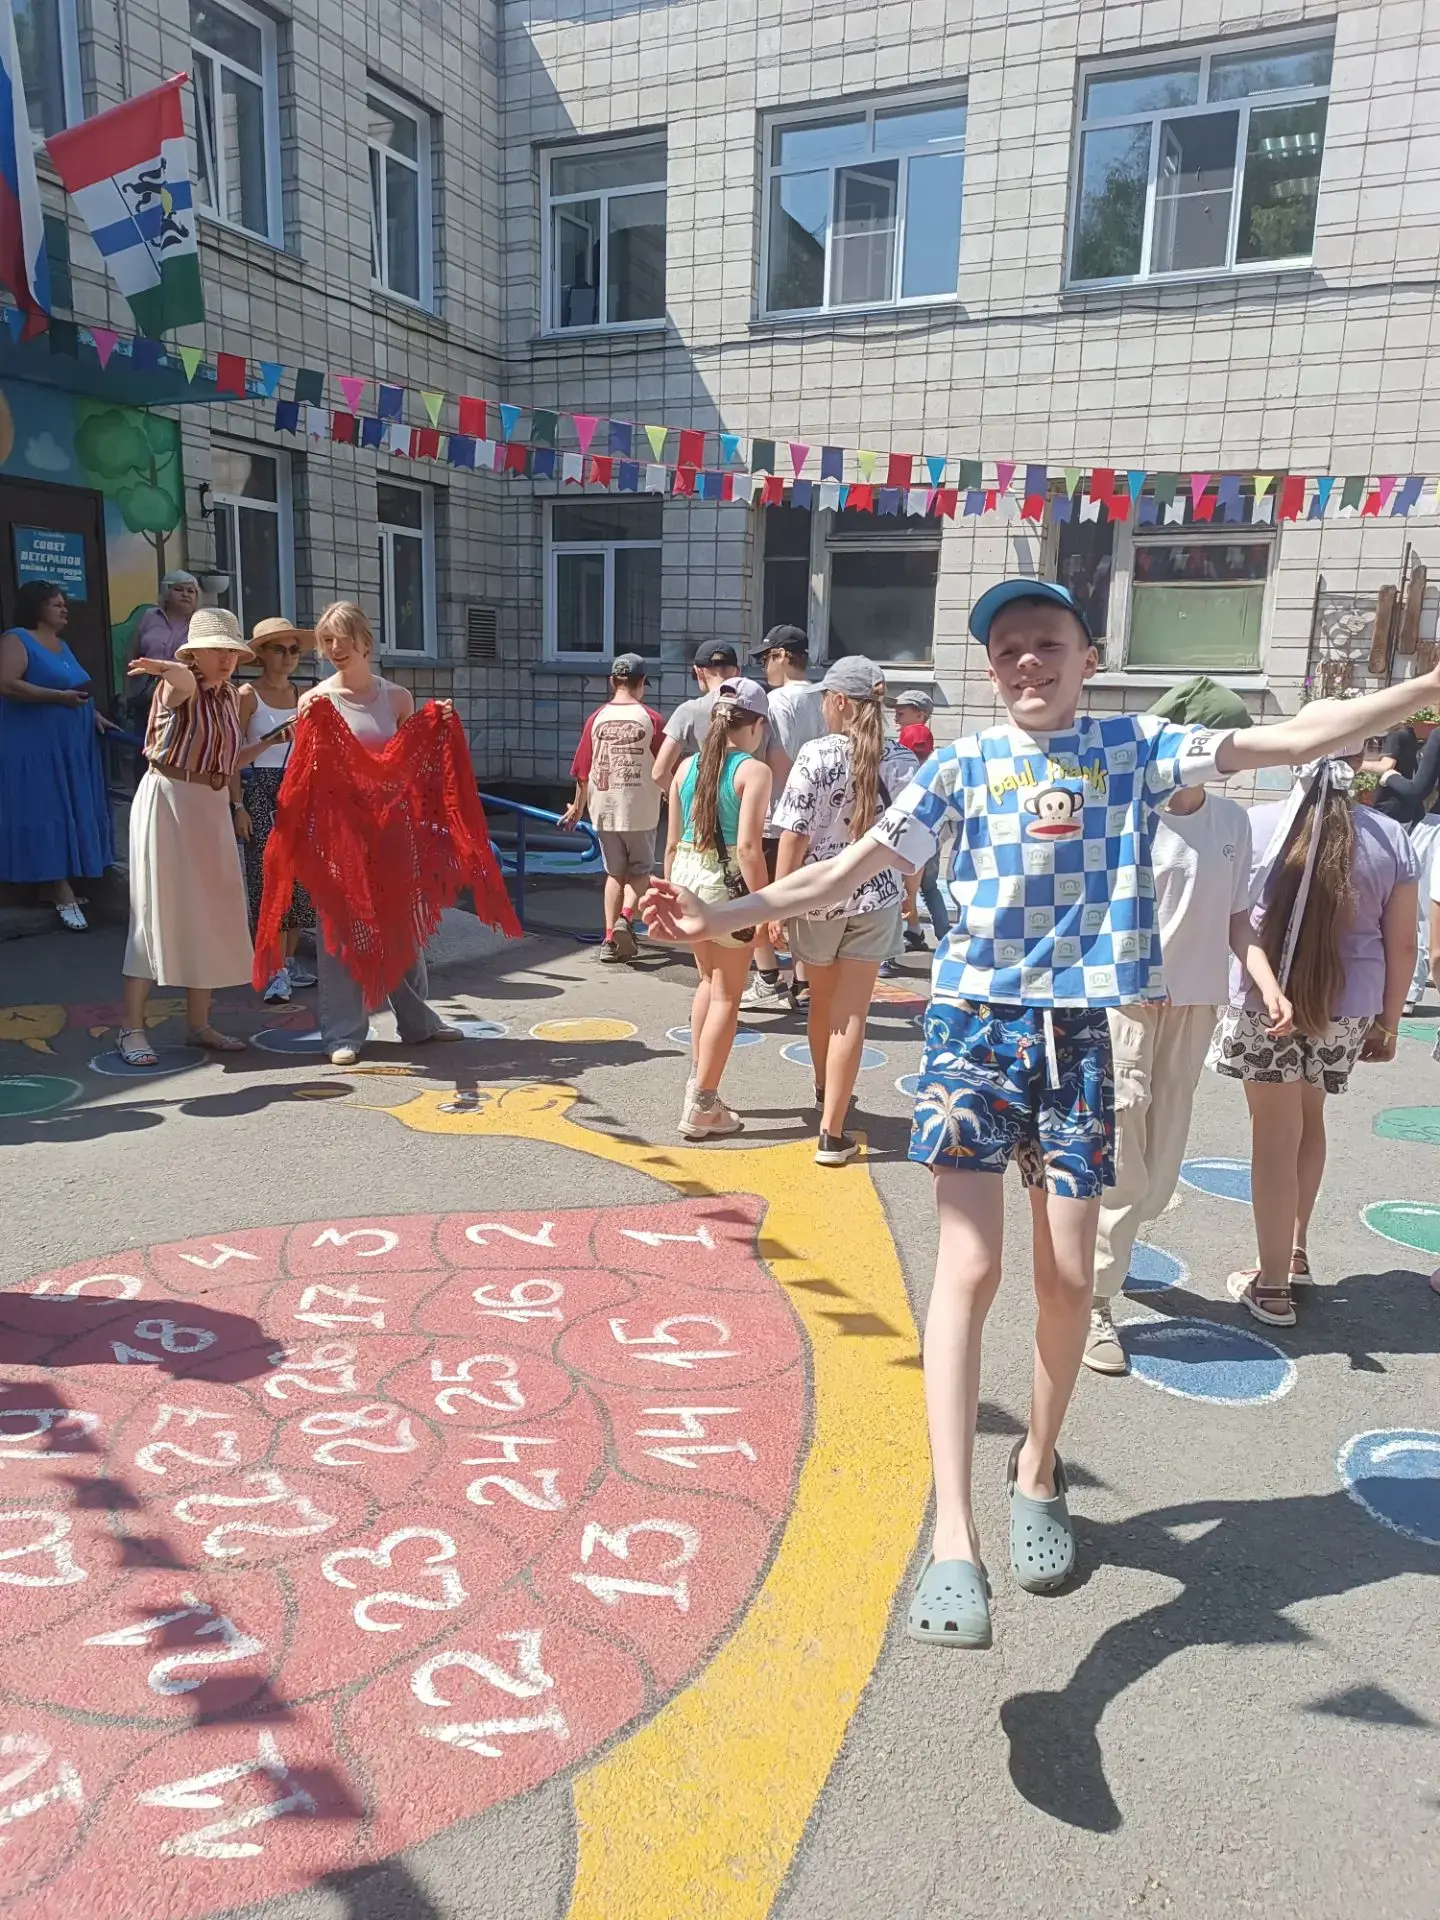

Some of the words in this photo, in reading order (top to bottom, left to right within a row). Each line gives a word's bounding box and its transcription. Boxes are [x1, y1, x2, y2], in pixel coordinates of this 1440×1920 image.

[33, 540, 66, 551] СОВЕТ
[990, 759, 1038, 805] paul
[179, 1243, 262, 1269] 4
[310, 1228, 399, 1257] 3
[465, 1221, 556, 1247] 2
[619, 1225, 716, 1249] 1
[30, 1273, 143, 1305] 5
[294, 1284, 386, 1329] 17
[472, 1279, 564, 1322] 16
[109, 1319, 218, 1364] 18
[607, 1314, 742, 1368] 15
[264, 1343, 358, 1399] 26
[431, 1354, 526, 1415] 25
[135, 1404, 241, 1475] 27
[300, 1402, 418, 1466] 28
[635, 1406, 757, 1469] 14
[461, 1433, 566, 1511] 24
[173, 1471, 338, 1558] 22
[320, 1526, 470, 1631] 23
[572, 1518, 699, 1612] 13
[83, 1591, 263, 1696] 21
[411, 1629, 570, 1757] 12
[137, 1729, 318, 1858] 11
